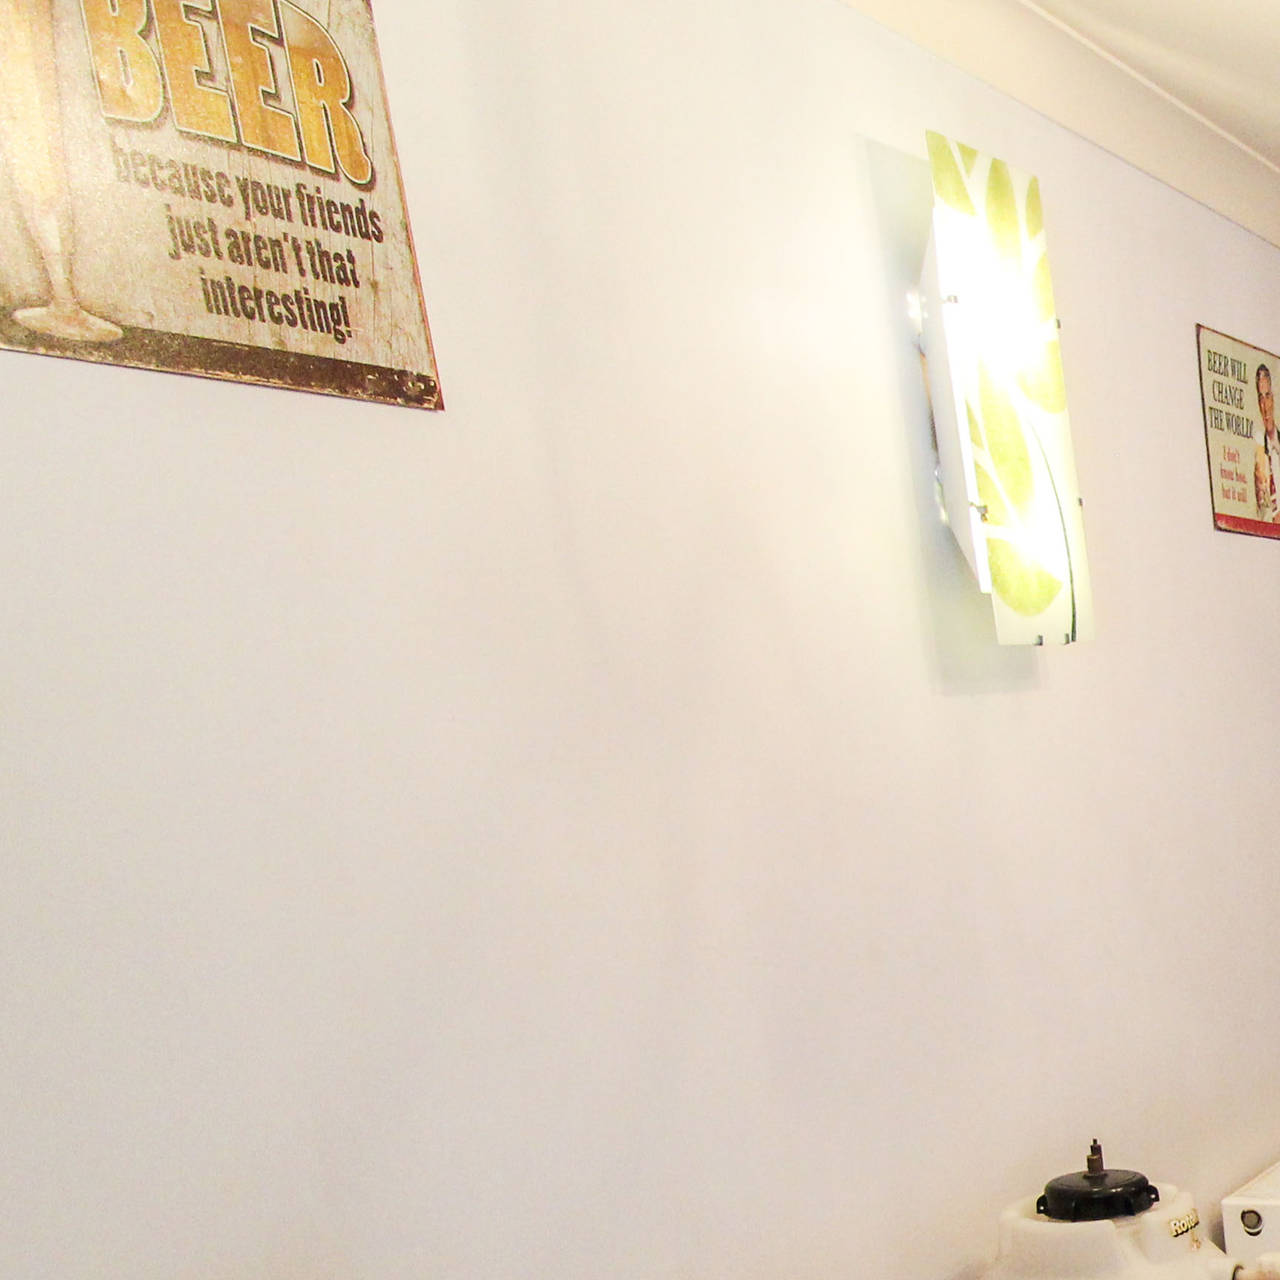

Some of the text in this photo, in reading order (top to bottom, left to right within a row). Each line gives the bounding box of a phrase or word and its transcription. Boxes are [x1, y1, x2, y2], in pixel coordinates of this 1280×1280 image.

[79, 0, 372, 186] BEER
[111, 143, 385, 243] because your friends
[166, 203, 361, 289] just aren't that
[200, 269, 354, 345] interesting!
[1207, 349, 1249, 384] BEER WILL
[1212, 380, 1245, 410] CHANGE
[1209, 406, 1225, 432] THE
